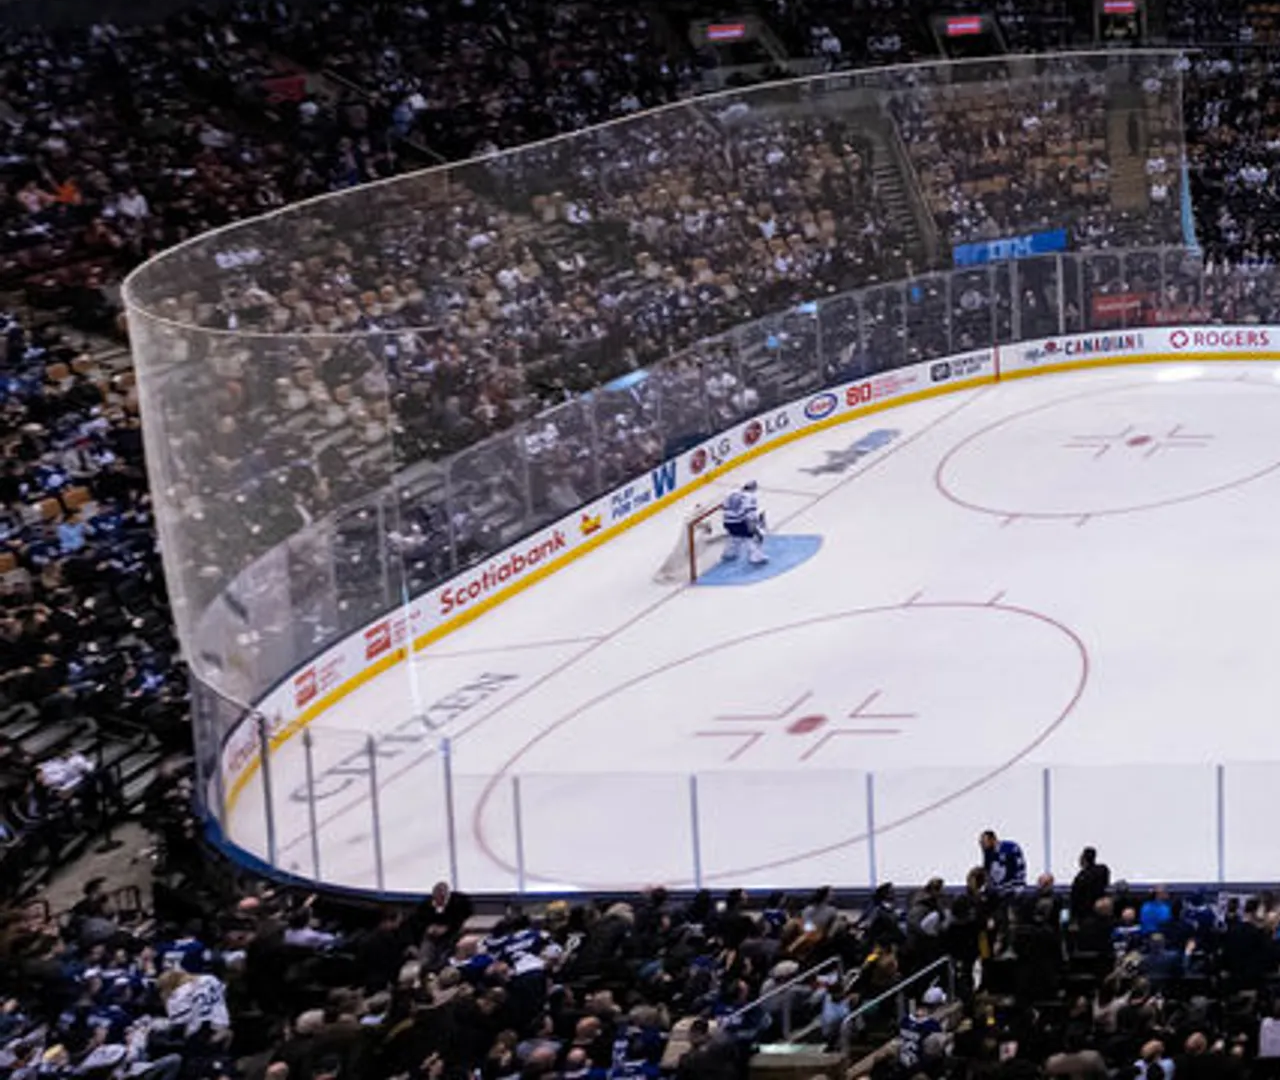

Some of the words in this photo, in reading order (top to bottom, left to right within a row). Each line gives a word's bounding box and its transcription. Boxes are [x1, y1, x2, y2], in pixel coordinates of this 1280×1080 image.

[989, 235, 1033, 260] IBM
[1193, 329, 1269, 348] ROGERS
[764, 411, 791, 438] LG
[709, 438, 732, 465] LG
[651, 460, 678, 499] W
[438, 528, 567, 615] Scotiabank
